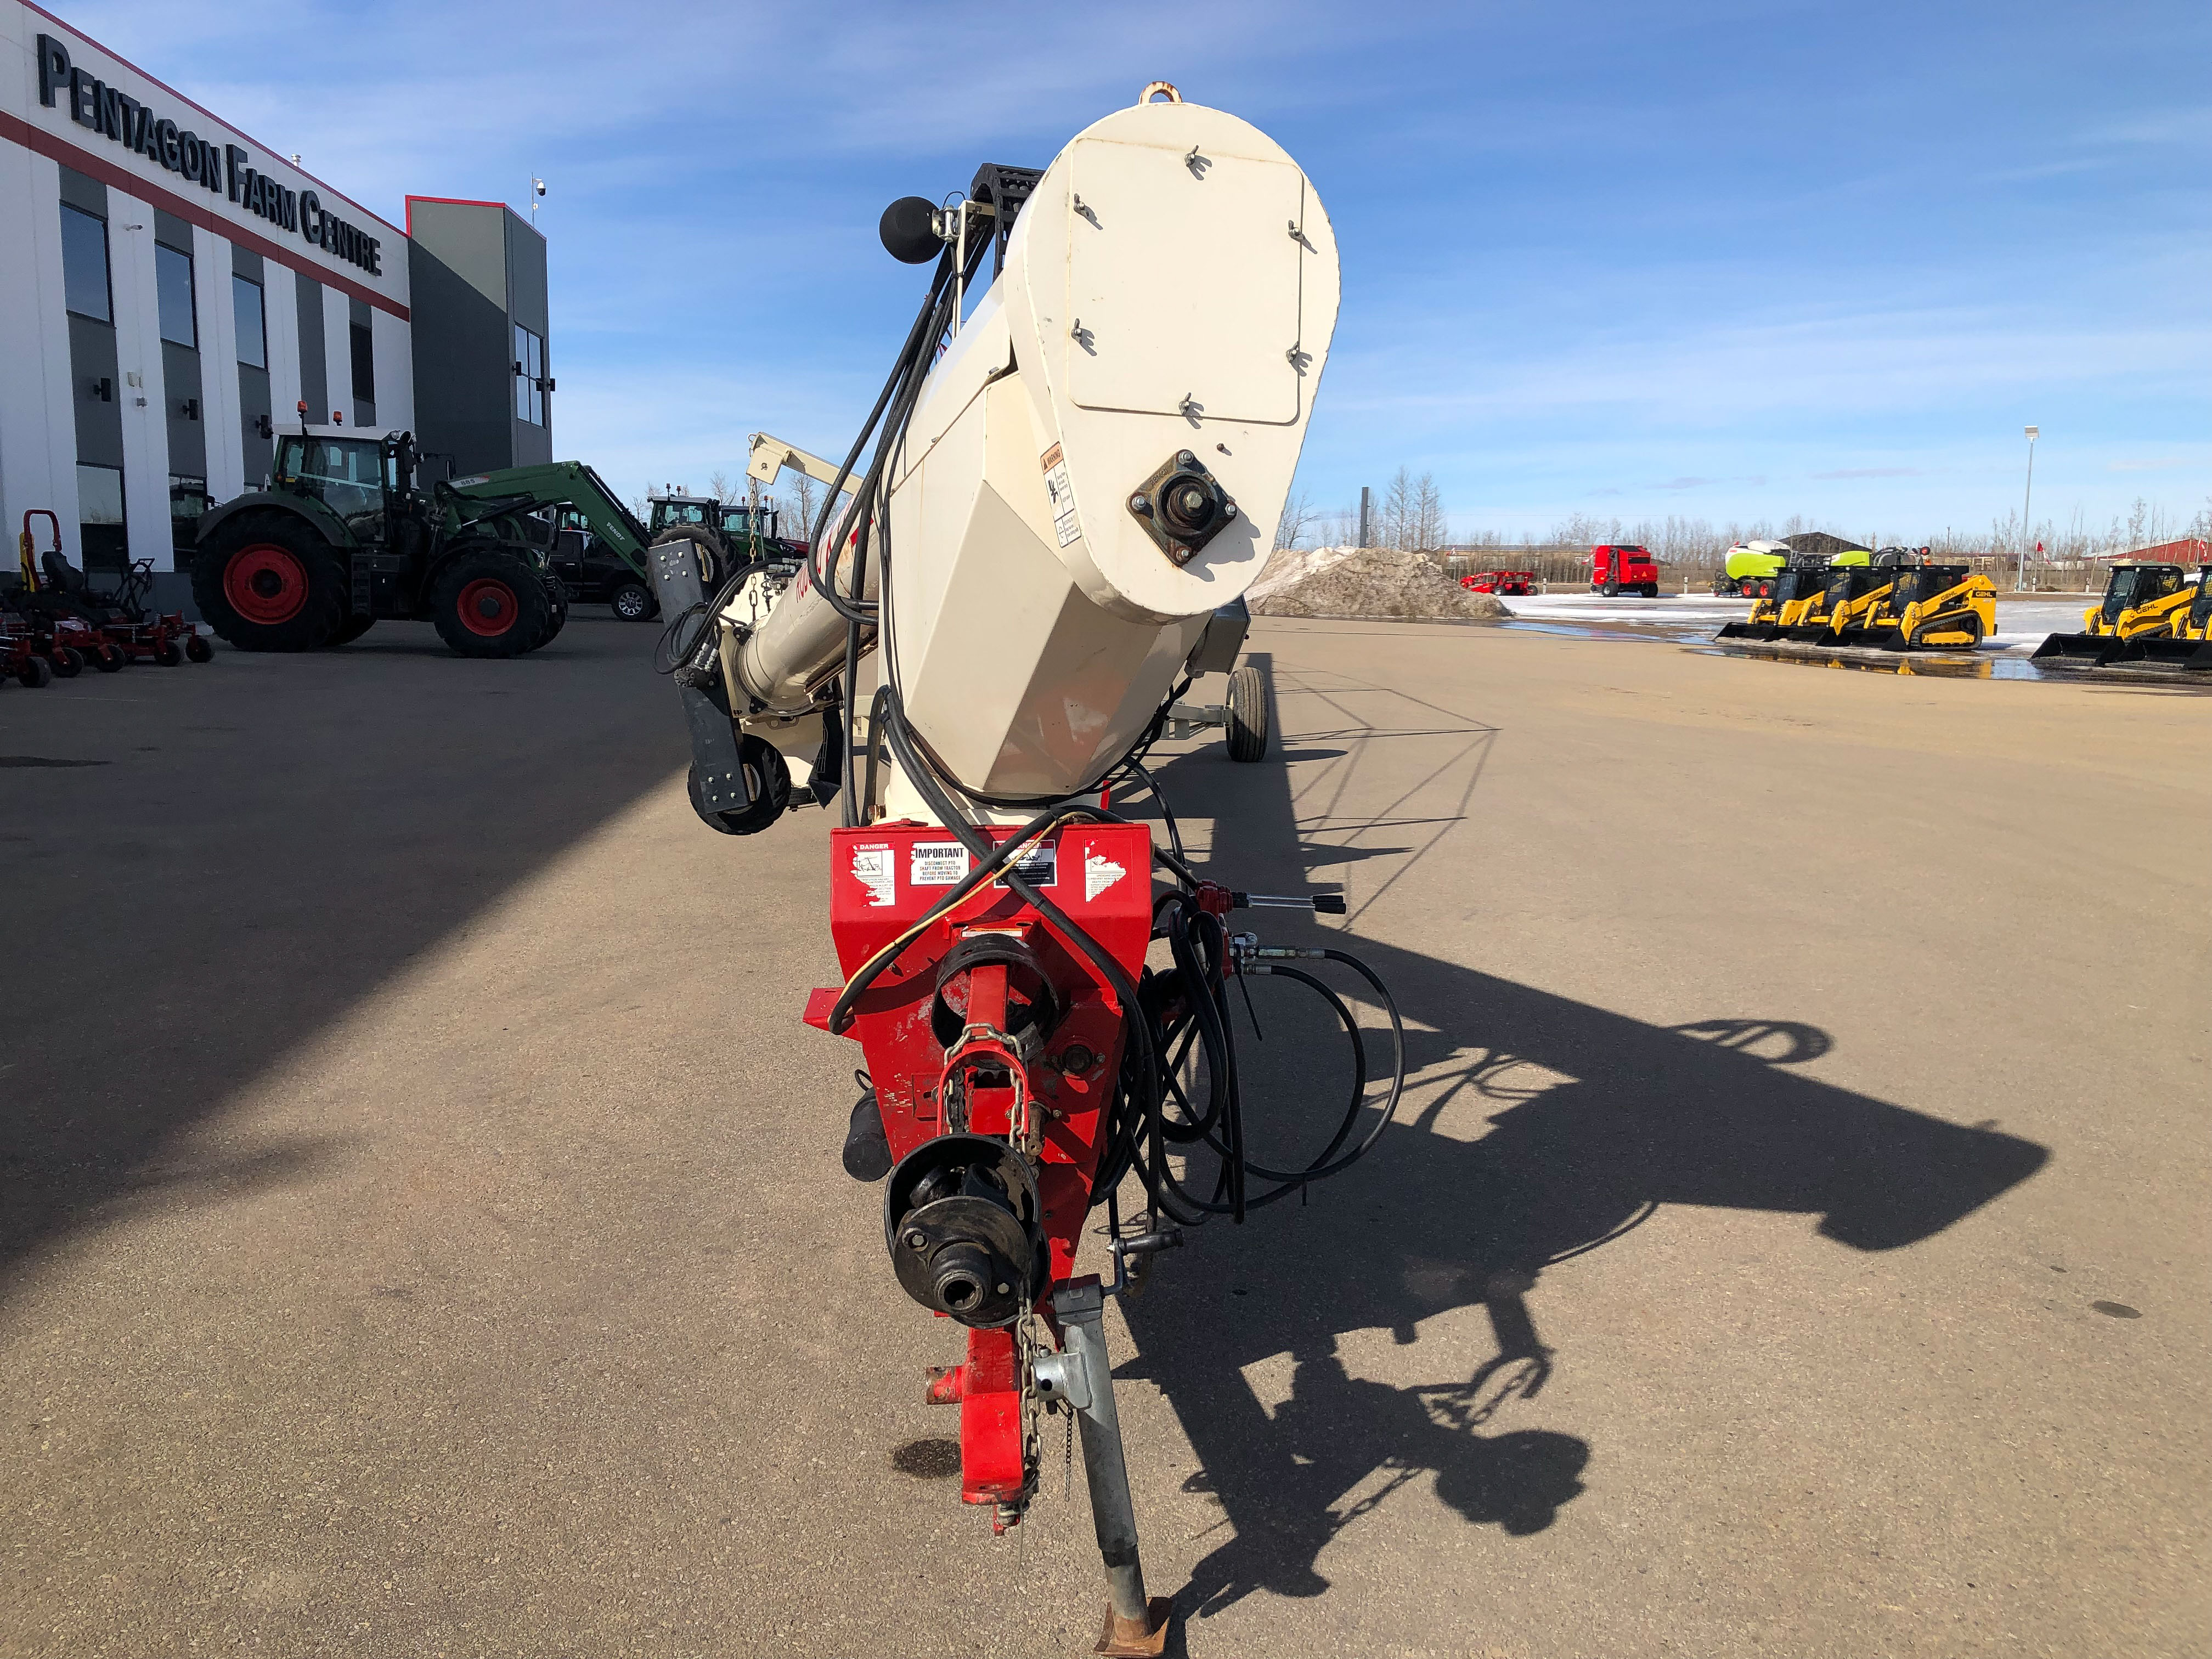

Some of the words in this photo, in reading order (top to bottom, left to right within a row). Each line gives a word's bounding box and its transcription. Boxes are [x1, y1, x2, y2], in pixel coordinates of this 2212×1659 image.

[36, 33, 222, 193] PENTAGON
[226, 144, 297, 233] FARM
[300, 190, 382, 276] CENTRE
[606, 522, 625, 540] FENDT
[1941, 591, 1957, 600] GEHL
[2136, 603, 2158, 614] GEHL
[915, 848, 964, 858] IMPORTANT
